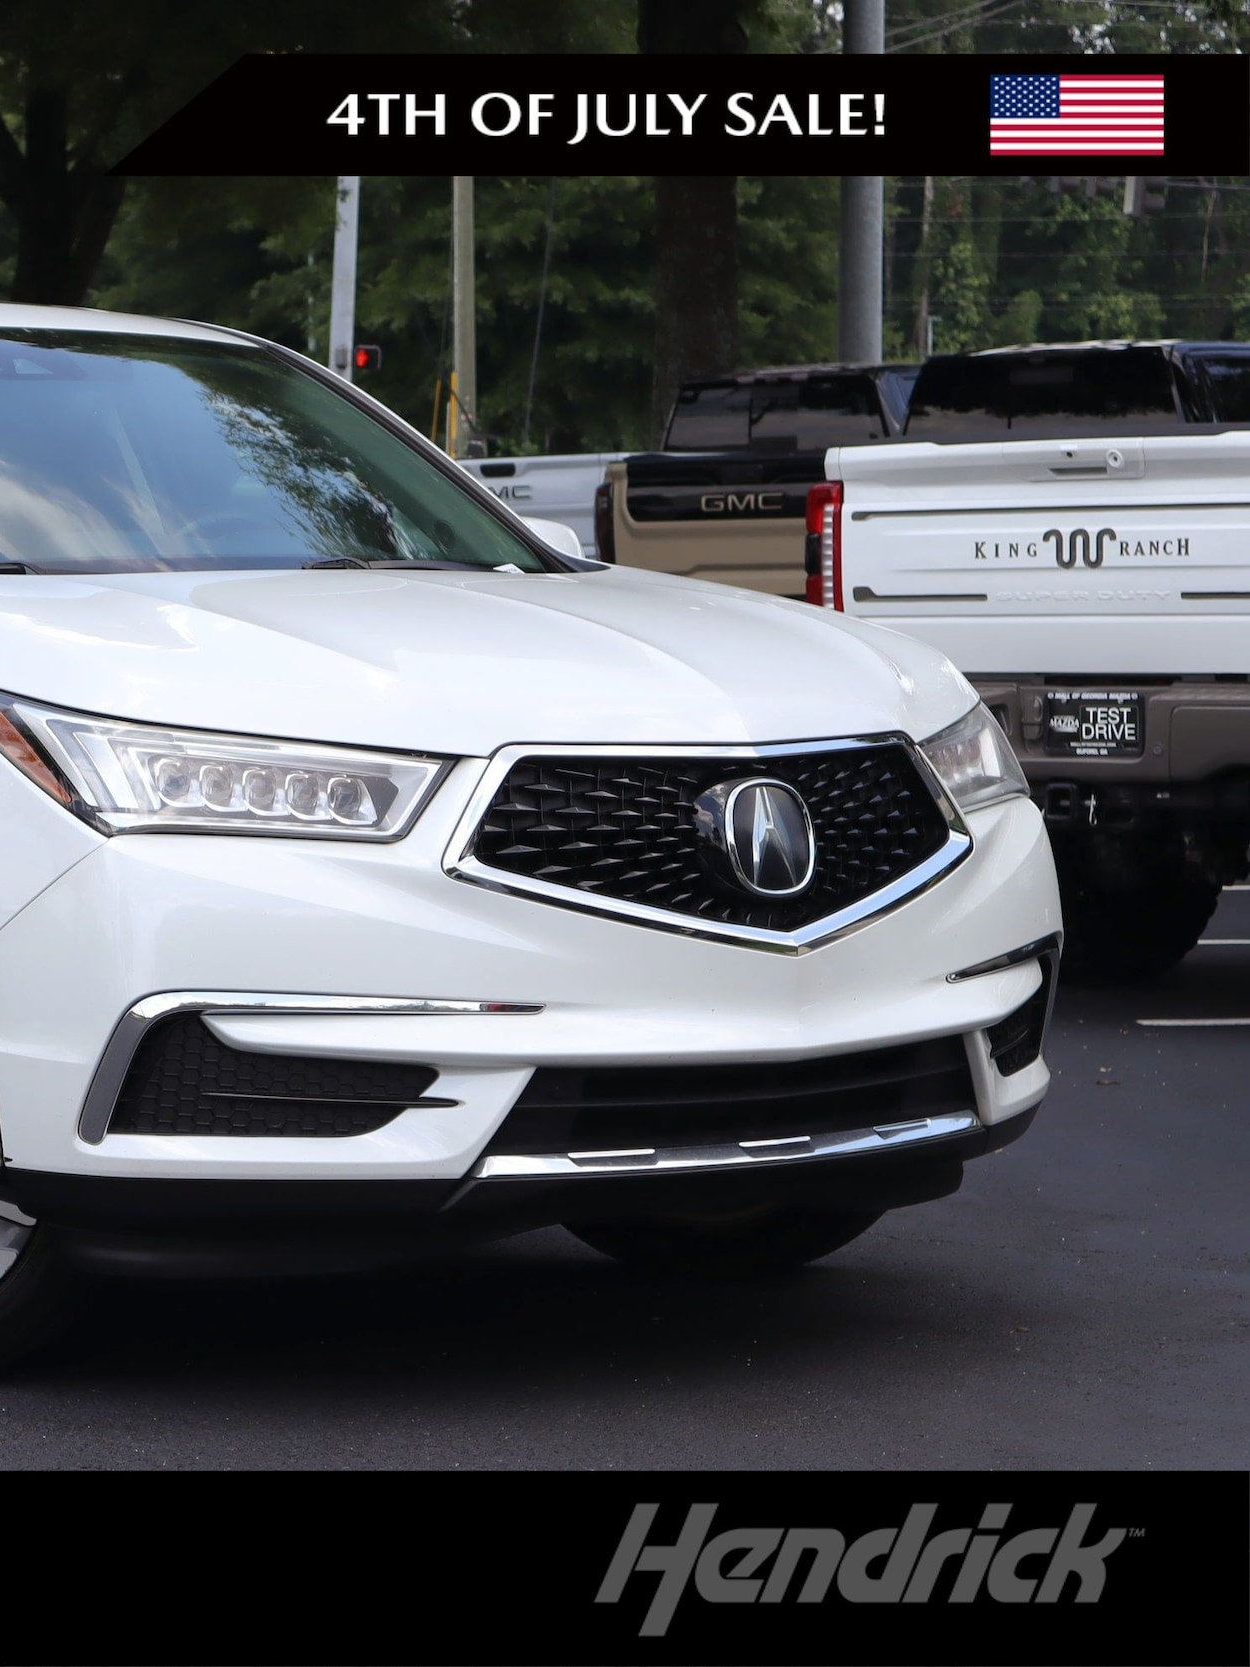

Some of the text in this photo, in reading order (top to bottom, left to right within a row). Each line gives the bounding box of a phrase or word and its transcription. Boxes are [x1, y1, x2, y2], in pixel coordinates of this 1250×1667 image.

[488, 485, 532, 499] MC
[701, 492, 783, 512] GMC
[974, 538, 1190, 559] KING RANCH
[996, 590, 1171, 602] SUPER DUTY
[1049, 717, 1080, 729] MAZDA
[1086, 707, 1132, 723] TEST
[1082, 723, 1137, 740] DRIVE
